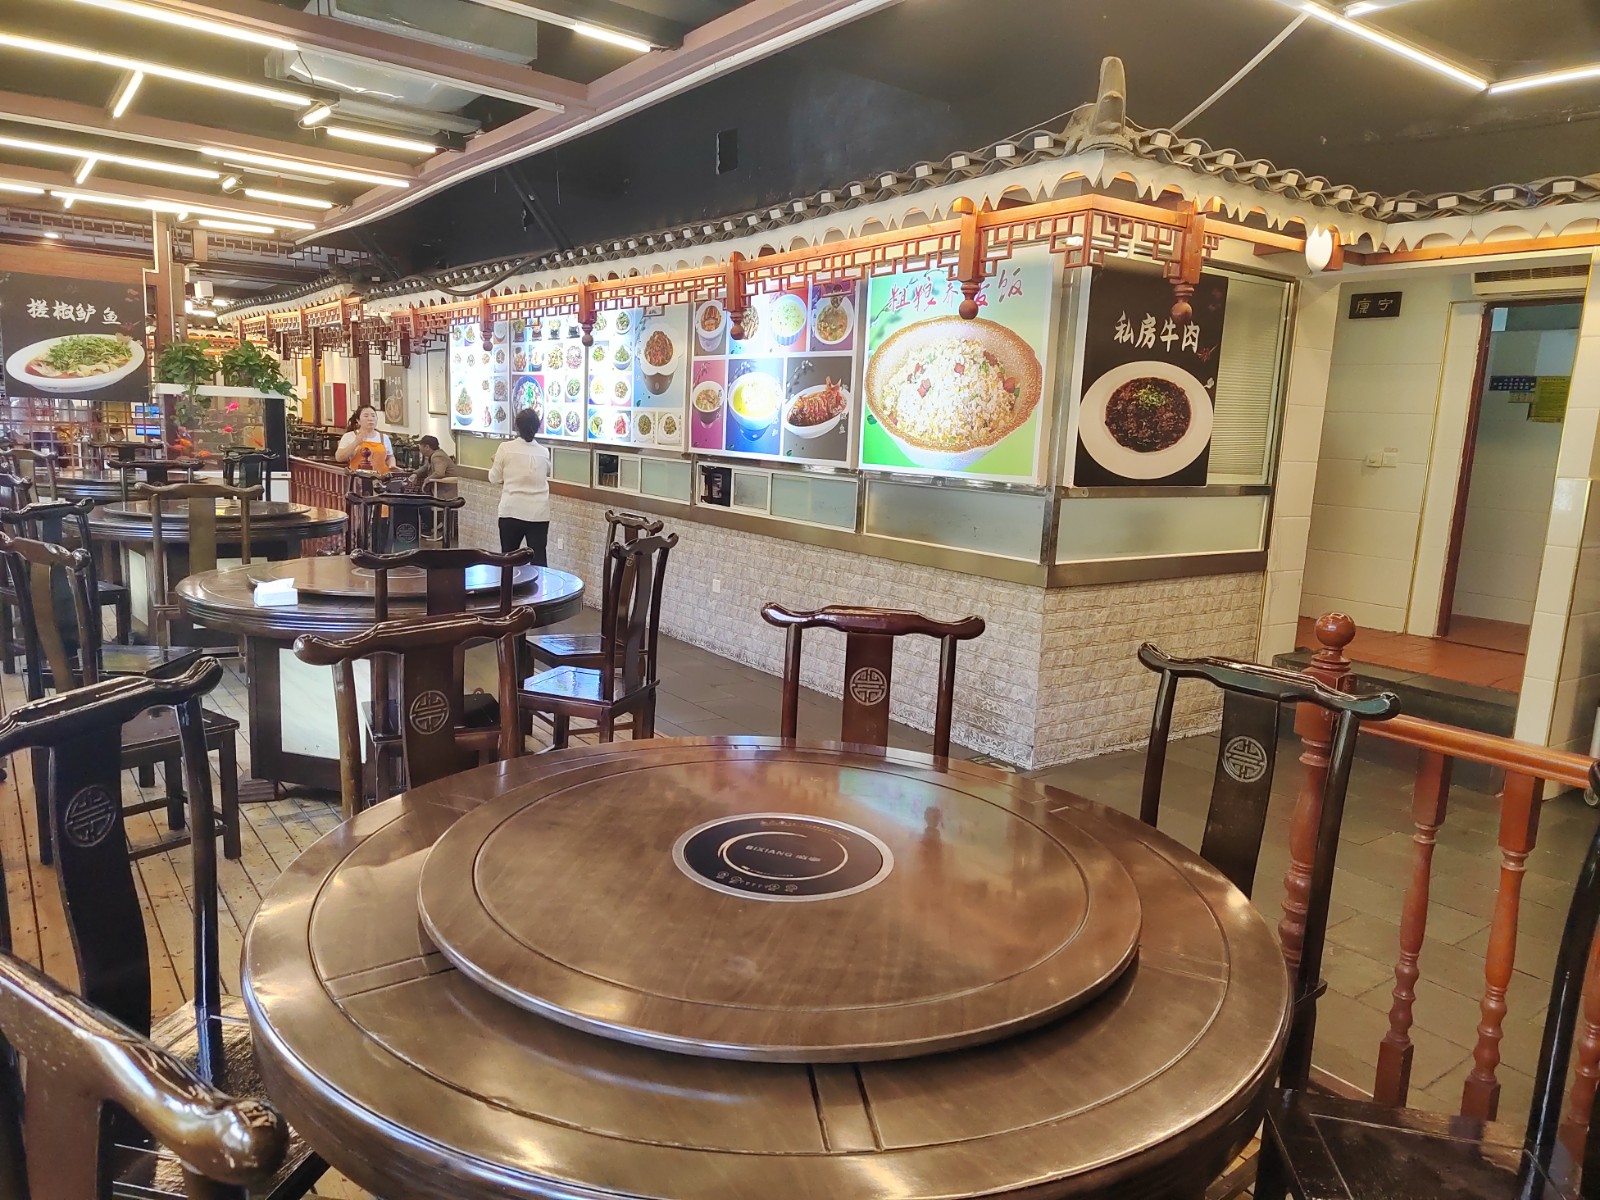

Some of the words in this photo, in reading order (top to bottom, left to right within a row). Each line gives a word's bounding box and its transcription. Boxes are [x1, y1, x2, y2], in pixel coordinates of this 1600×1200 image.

[1113, 310, 1200, 354] 私房牛肉
[745, 844, 793, 858] BIXIANG
